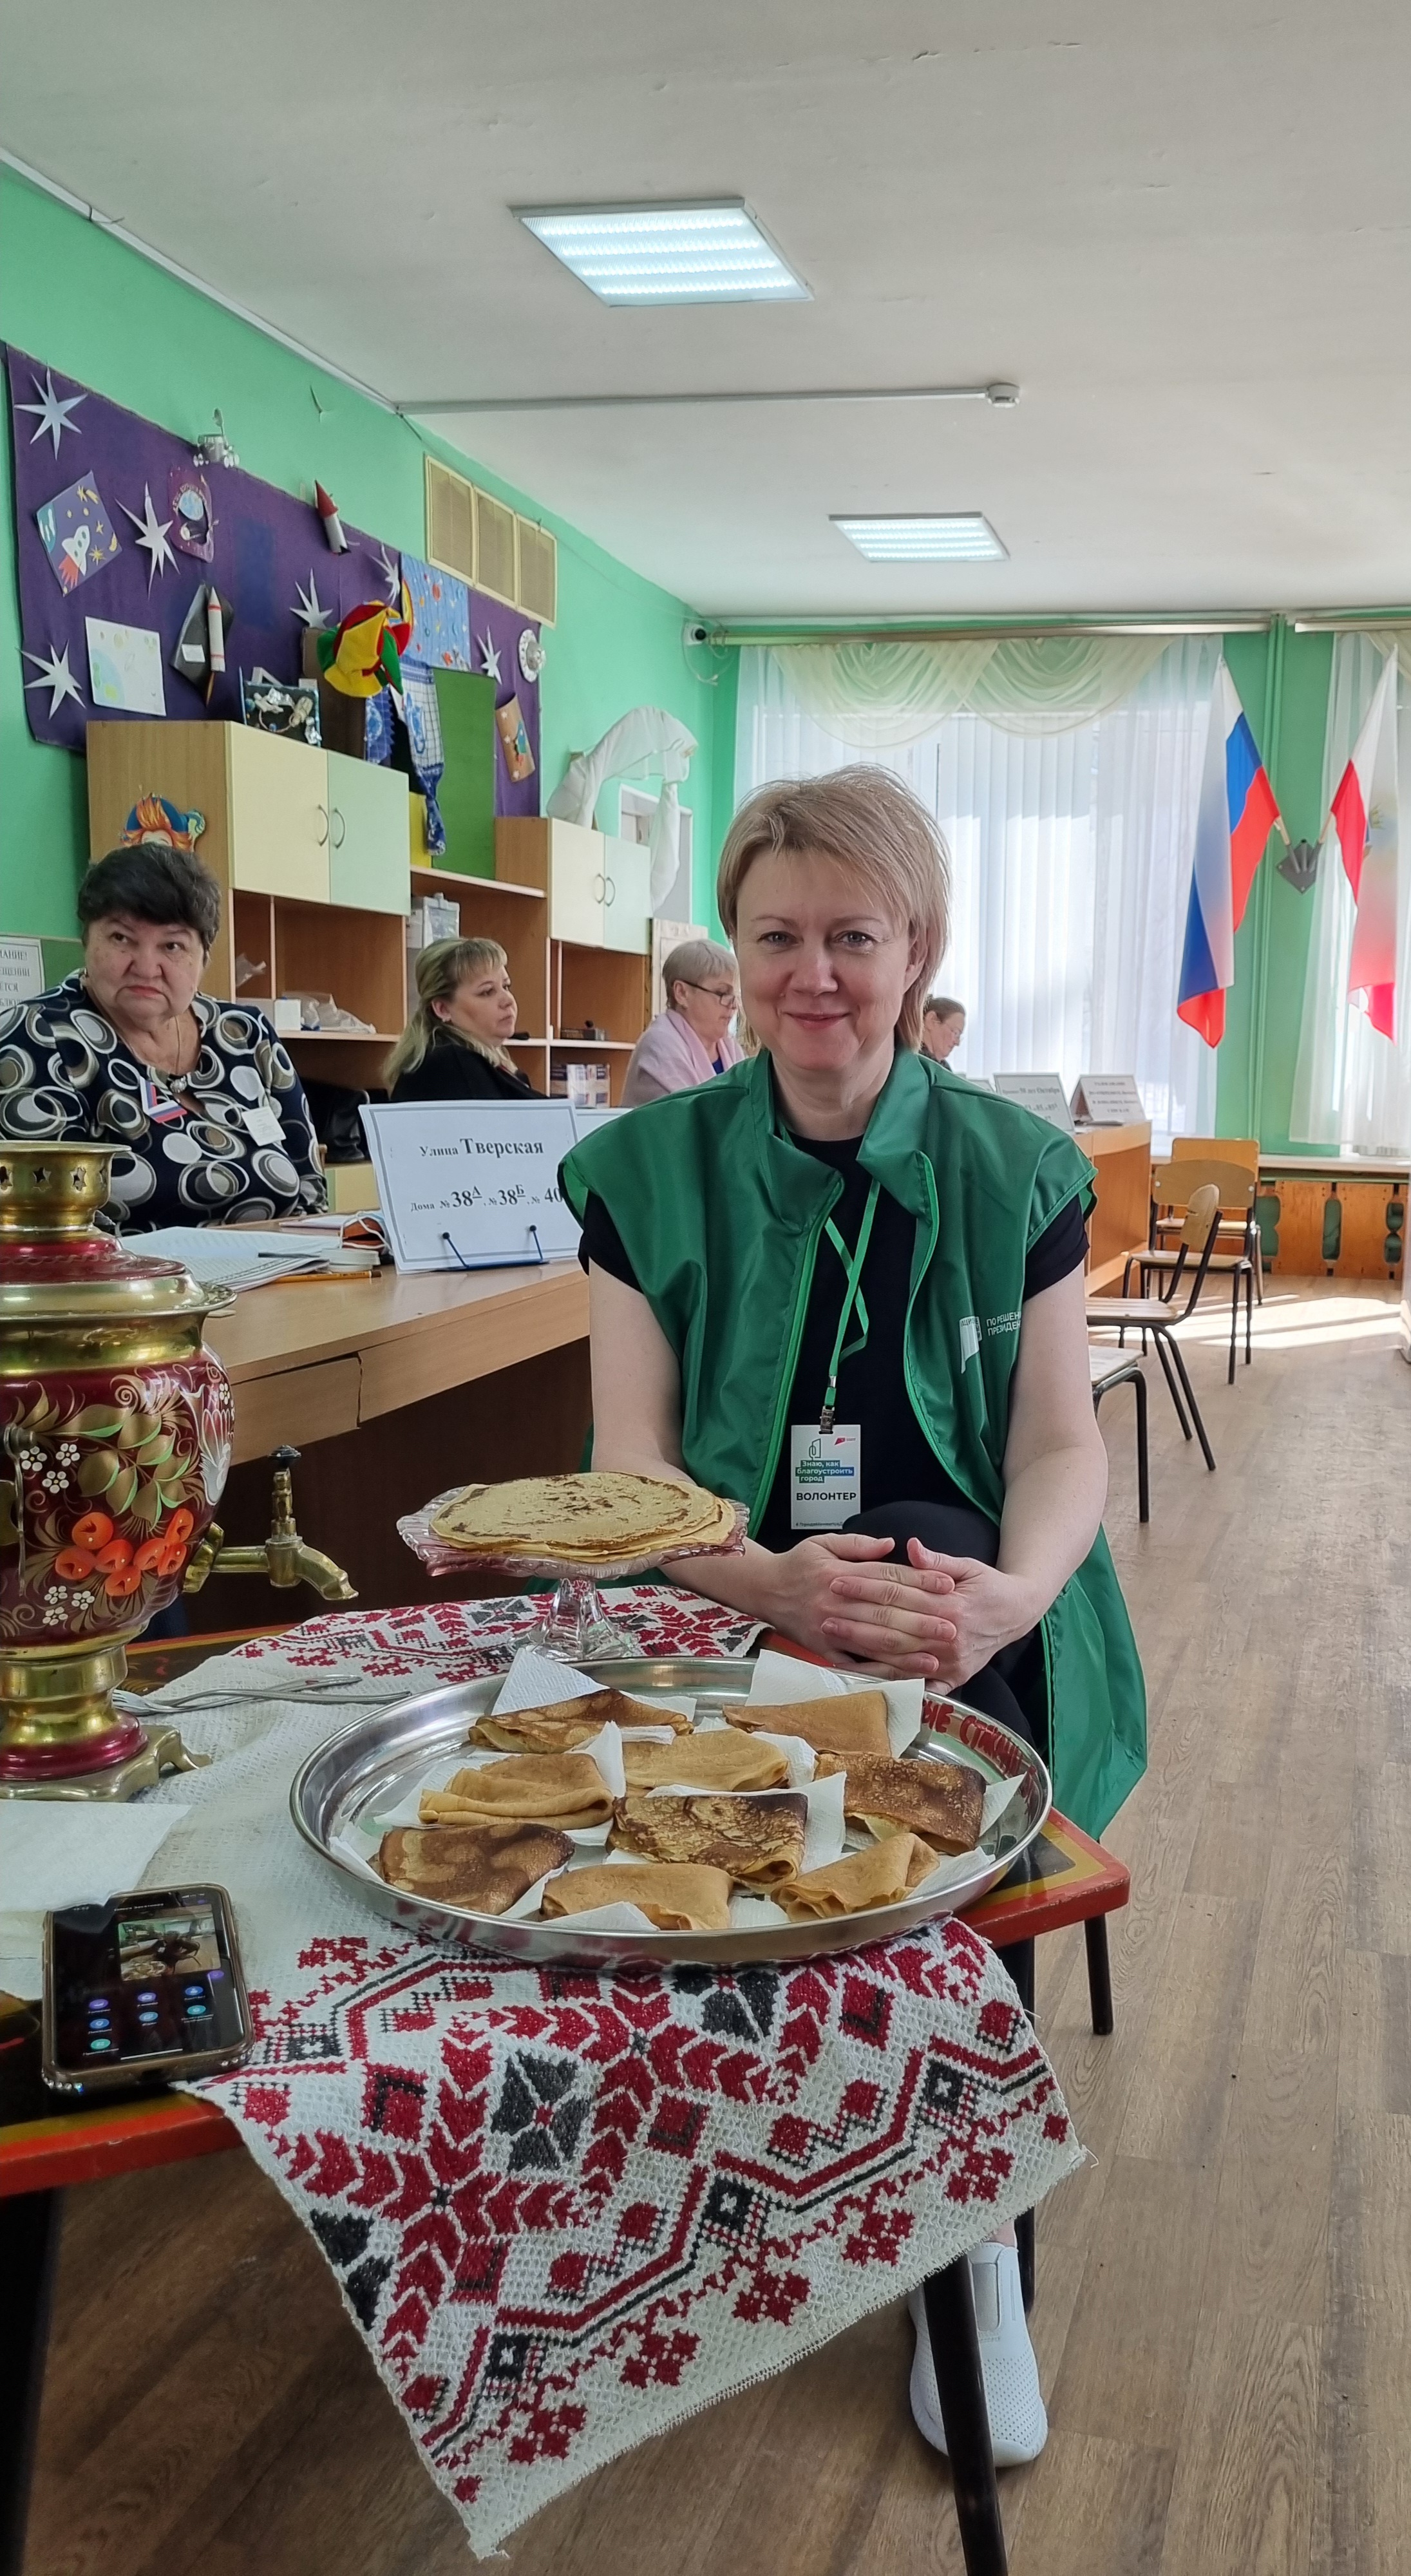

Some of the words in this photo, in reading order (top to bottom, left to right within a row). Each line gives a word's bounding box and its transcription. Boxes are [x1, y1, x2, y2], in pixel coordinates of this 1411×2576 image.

[419, 1146, 459, 1157] Улица
[460, 1138, 544, 1159] Тверская
[411, 1202, 435, 1212] Дома
[987, 1318, 997, 1327] ПО
[796, 1492, 857, 1501] ВОЛОНТЕР
